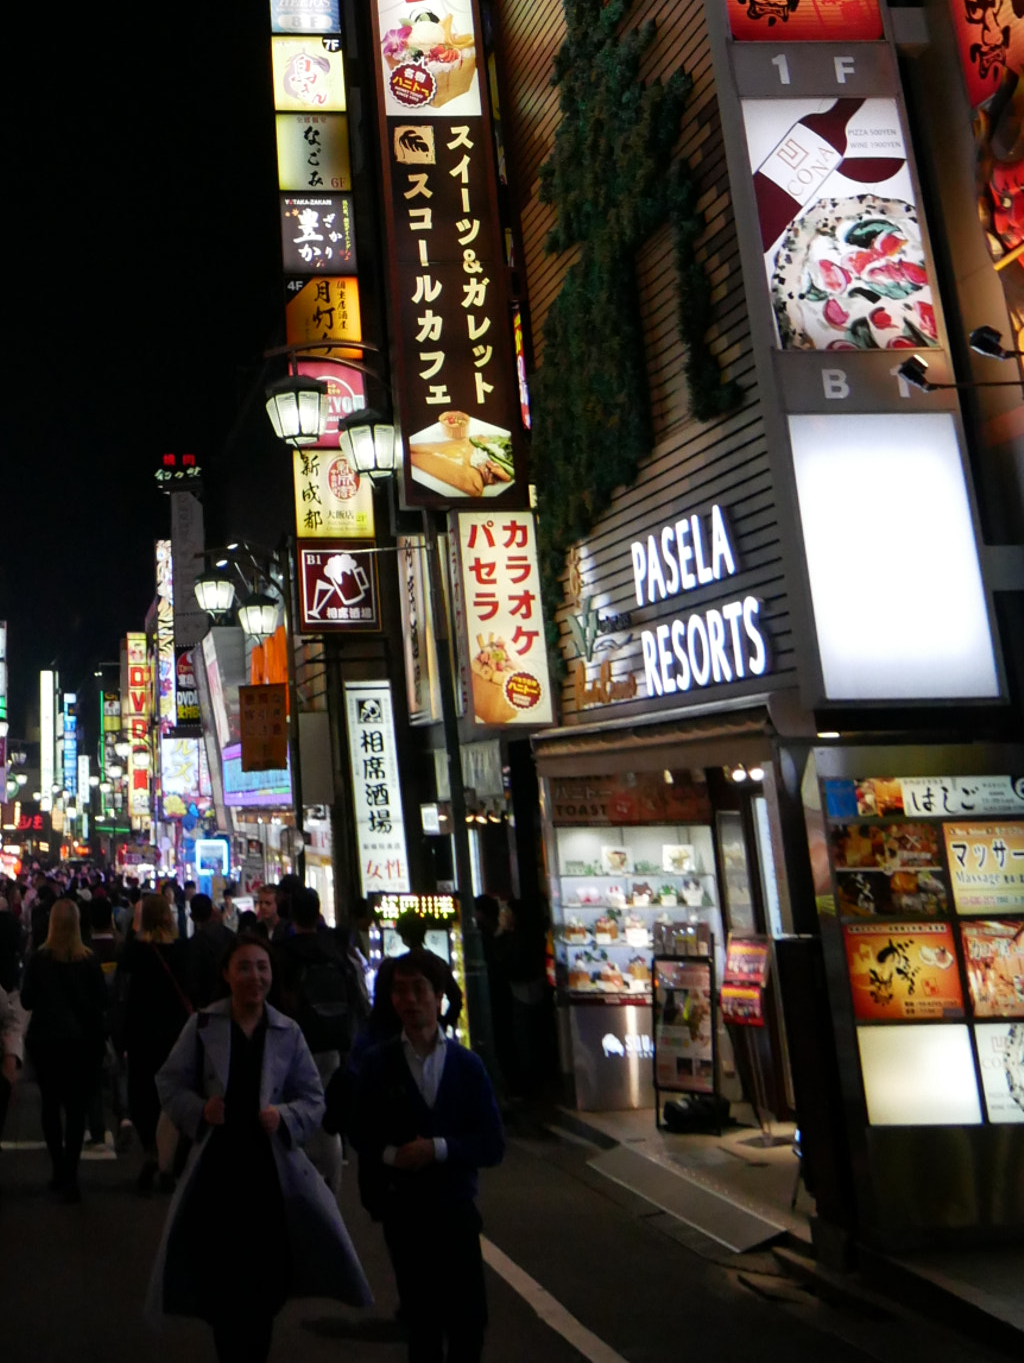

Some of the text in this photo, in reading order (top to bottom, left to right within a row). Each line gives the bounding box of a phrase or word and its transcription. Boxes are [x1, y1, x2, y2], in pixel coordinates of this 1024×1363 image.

[322, 39, 340, 51] 7F
[330, 177, 347, 189] 6F
[786, 146, 835, 198] CONA
[287, 281, 304, 292] 4F
[403, 172, 451, 405] スコールカフェ
[446, 125, 495, 405] スイーツ&ガレット
[306, 554, 322, 566] B1
[467, 520, 501, 623] パセラ
[502, 519, 540, 656] カラオケ
[630, 503, 737, 607] PASELA
[641, 595, 767, 698] RESORTS
[360, 728, 393, 834] 相席酒場
